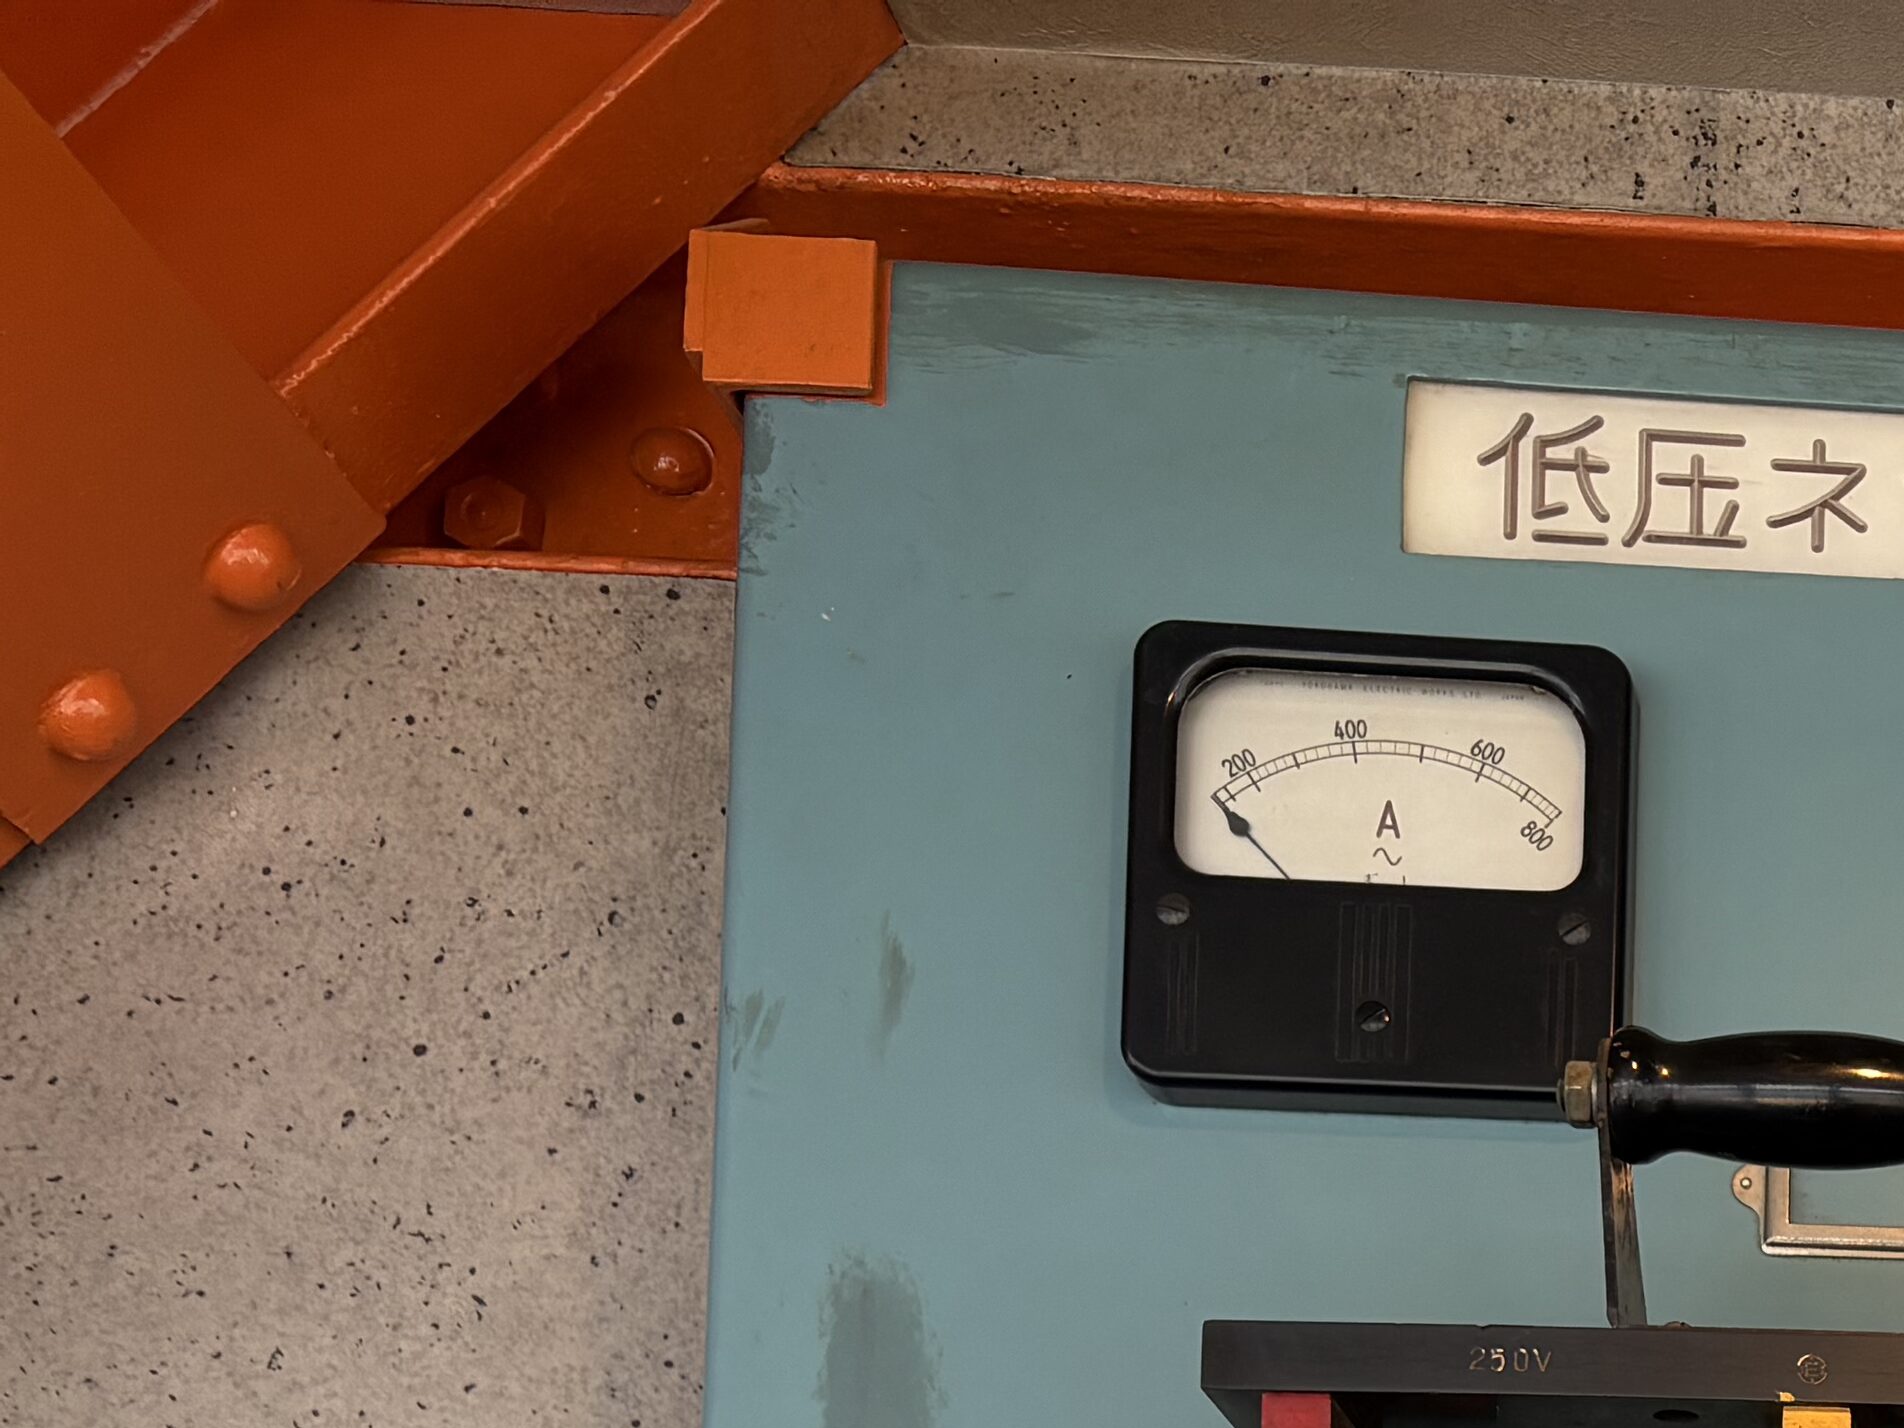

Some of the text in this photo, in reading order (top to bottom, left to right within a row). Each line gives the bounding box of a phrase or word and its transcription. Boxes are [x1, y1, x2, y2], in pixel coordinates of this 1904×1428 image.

[1334, 720, 1367, 740] 400
[1221, 748, 1256, 777] 200
[1470, 738, 1505, 765] 600
[1376, 800, 1401, 840] A
[1519, 820, 1554, 852] 800
[1469, 1347, 1552, 1373] 250V
